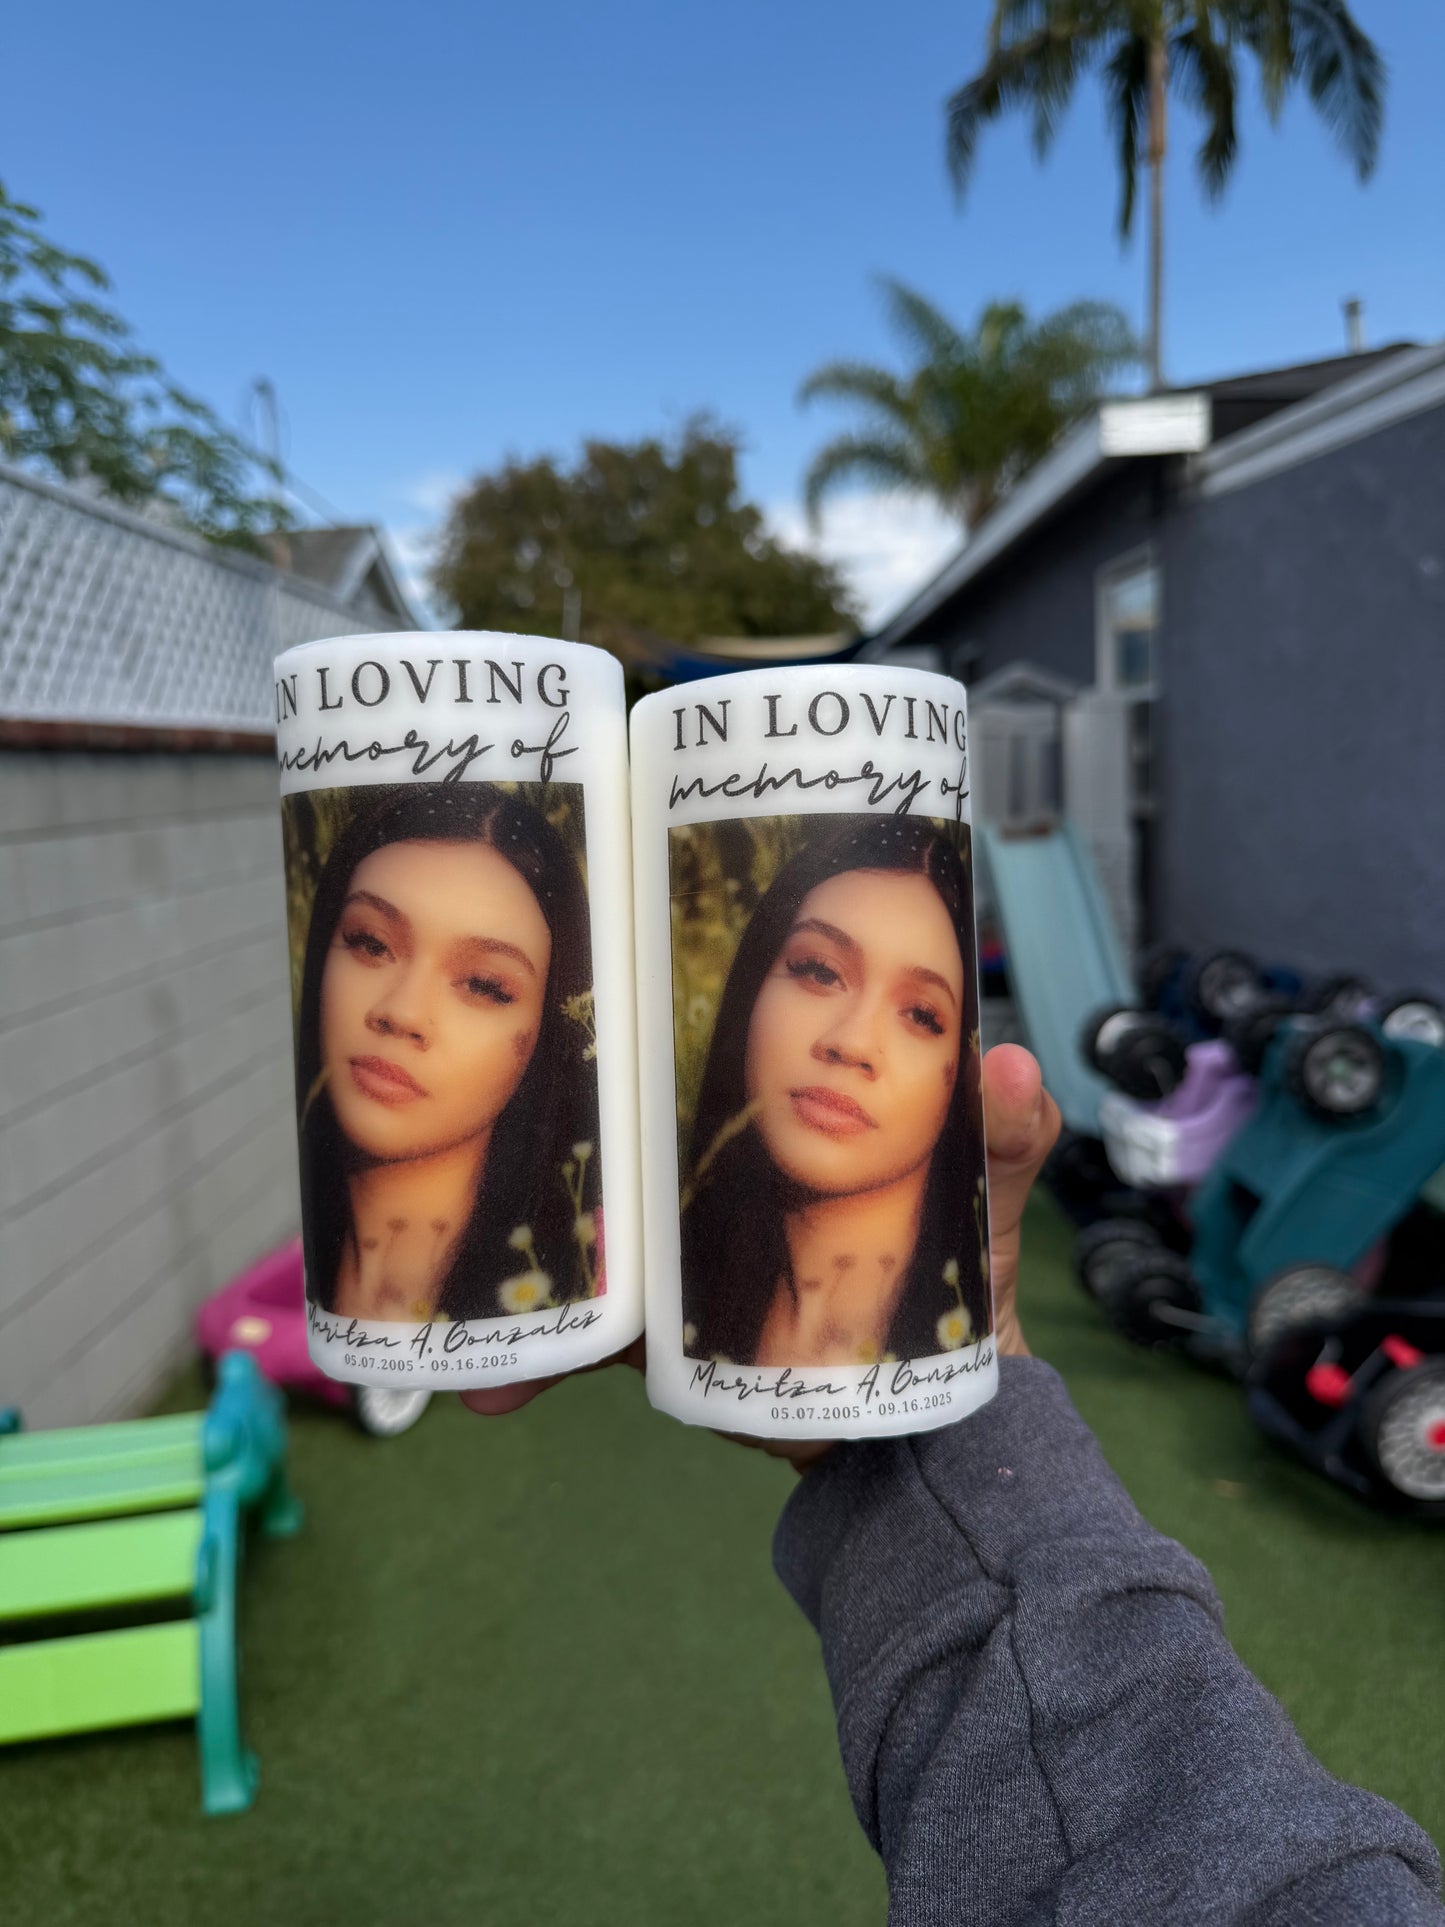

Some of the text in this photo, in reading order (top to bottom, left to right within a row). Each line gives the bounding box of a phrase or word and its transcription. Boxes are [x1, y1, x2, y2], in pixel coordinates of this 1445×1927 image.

[276, 659, 571, 724] IN LOVING
[511, 711, 580, 784] of
[672, 691, 967, 752] IN LOVING
[669, 755, 970, 821] memory of
[410, 1322, 432, 1359] A.
[443, 1303, 604, 1353] Gonzalez
[344, 1352, 414, 1372] 05.07.2005
[431, 1352, 519, 1372] 09.16.2025
[689, 1361, 847, 1400] Maritza
[856, 1362, 881, 1404] A.
[770, 1405, 861, 1420] 05.07.2005
[878, 1391, 953, 1416] 09.16.2025
